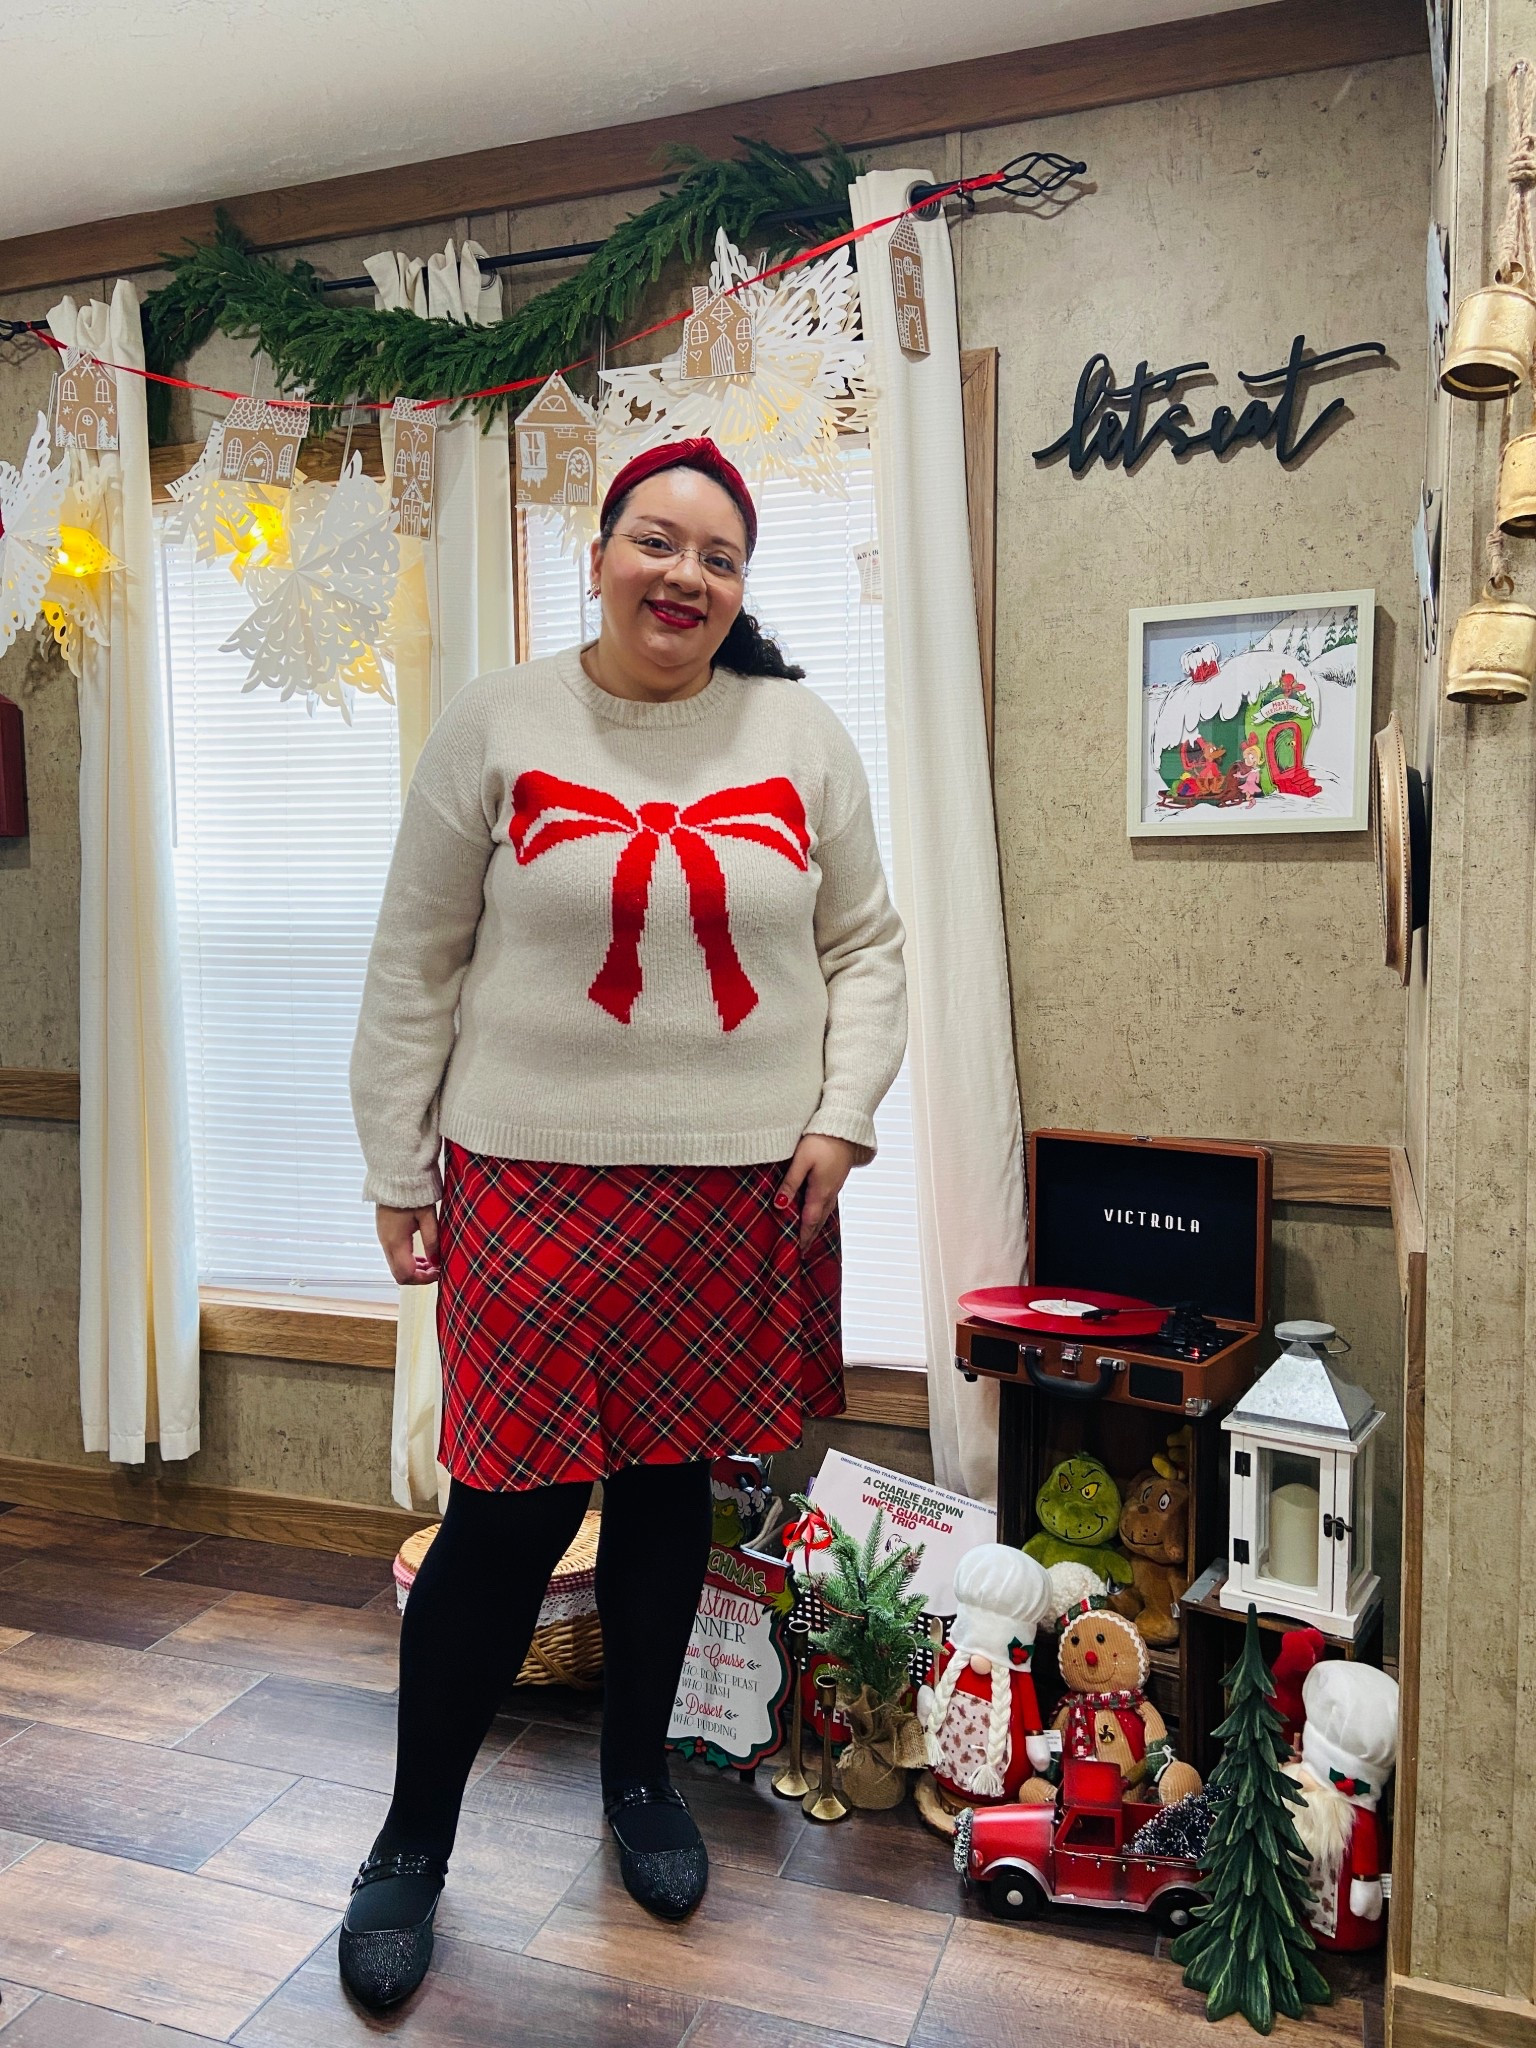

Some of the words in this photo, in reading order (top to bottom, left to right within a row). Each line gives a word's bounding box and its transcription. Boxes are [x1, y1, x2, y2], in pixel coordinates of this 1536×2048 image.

[1210, 335, 1387, 463] eat
[1104, 1208, 1200, 1234] VICTROLA
[864, 1465, 881, 1475] SOUND
[881, 1471, 898, 1480] TRACK
[863, 1476, 872, 1486] A
[873, 1479, 921, 1502] CHARLIE
[922, 1496, 964, 1519] BROWN
[878, 1490, 943, 1521] CHRISTMAS
[862, 1494, 895, 1513] VINCE
[896, 1507, 953, 1534] GUARALDI
[891, 1514, 917, 1530] TRIO
[707, 1548, 767, 1597] CHMAS
[697, 1587, 762, 1626] istmas
[694, 1614, 746, 1645] NNER
[685, 1643, 701, 1659] ain
[703, 1643, 746, 1671] Course
[685, 1692, 723, 1719] Dessert
